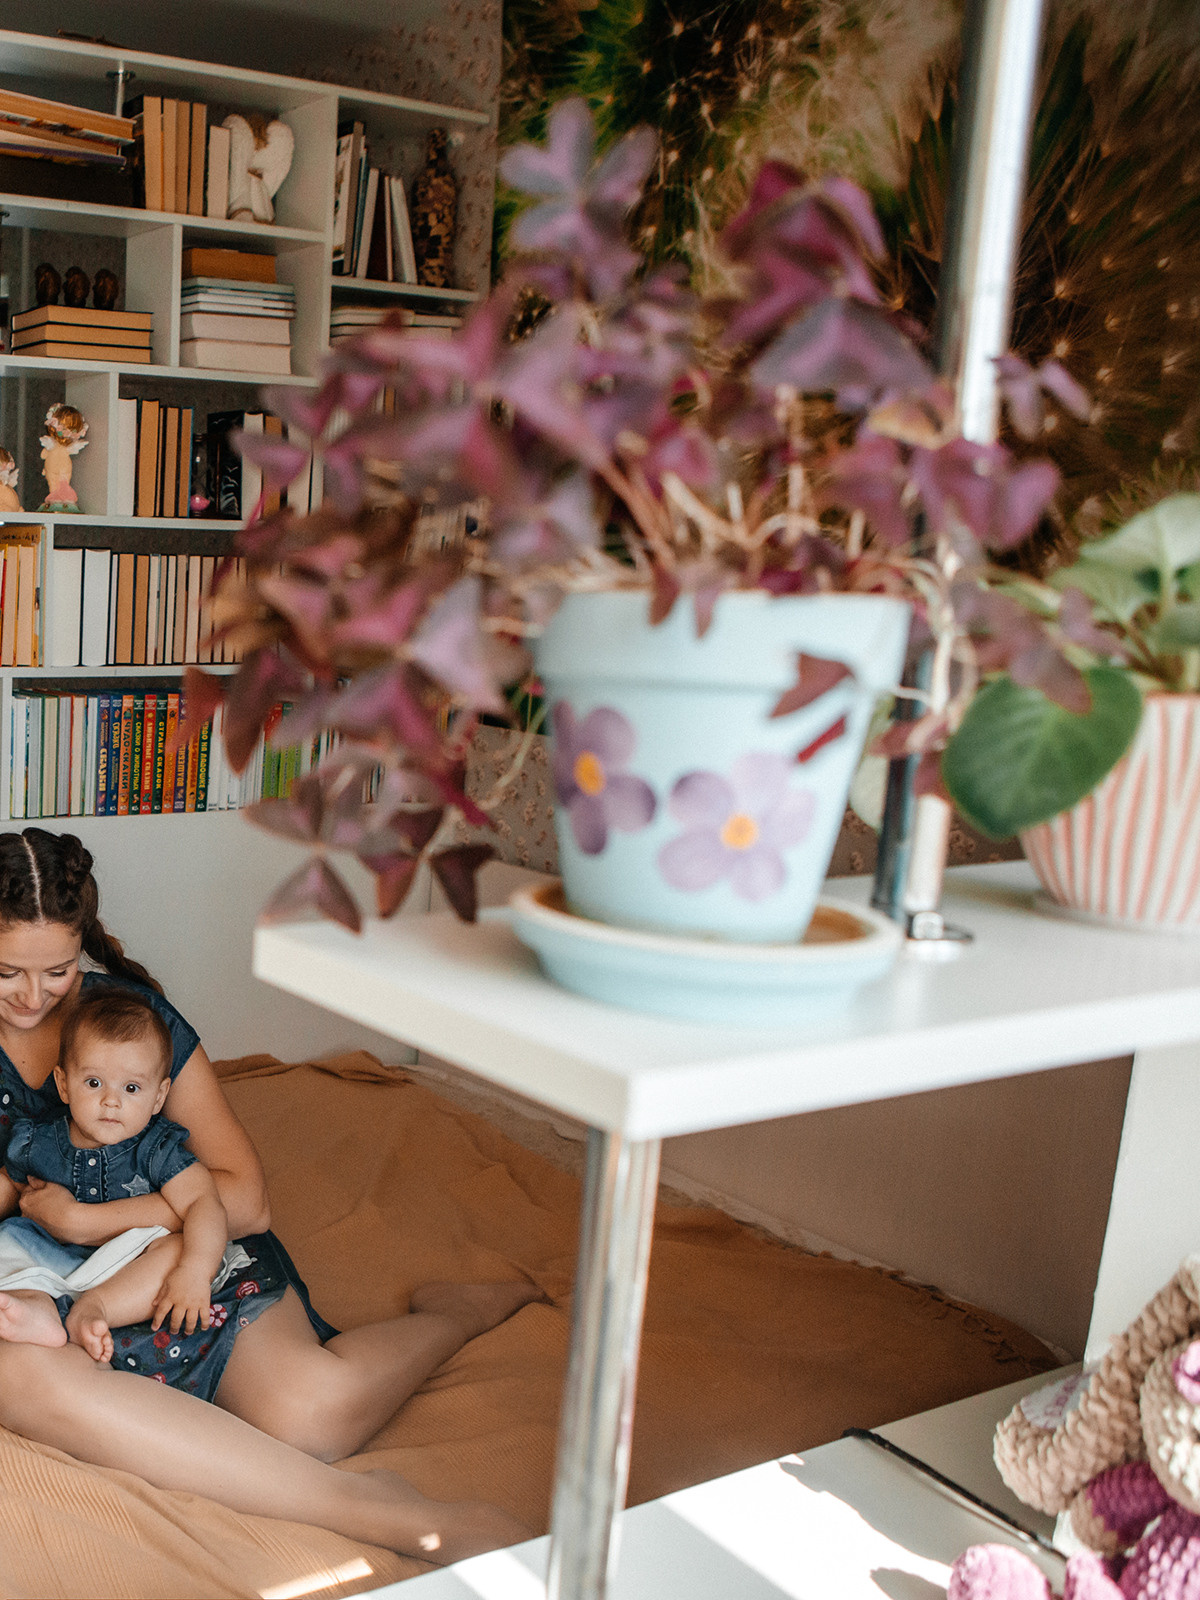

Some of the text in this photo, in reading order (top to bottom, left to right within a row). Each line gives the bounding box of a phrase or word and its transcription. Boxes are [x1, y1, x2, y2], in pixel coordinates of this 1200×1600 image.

[201, 741, 208, 752] НА
[98, 748, 107, 791] СКАЗКИ
[199, 753, 208, 788] ЛАДОШКЕ
